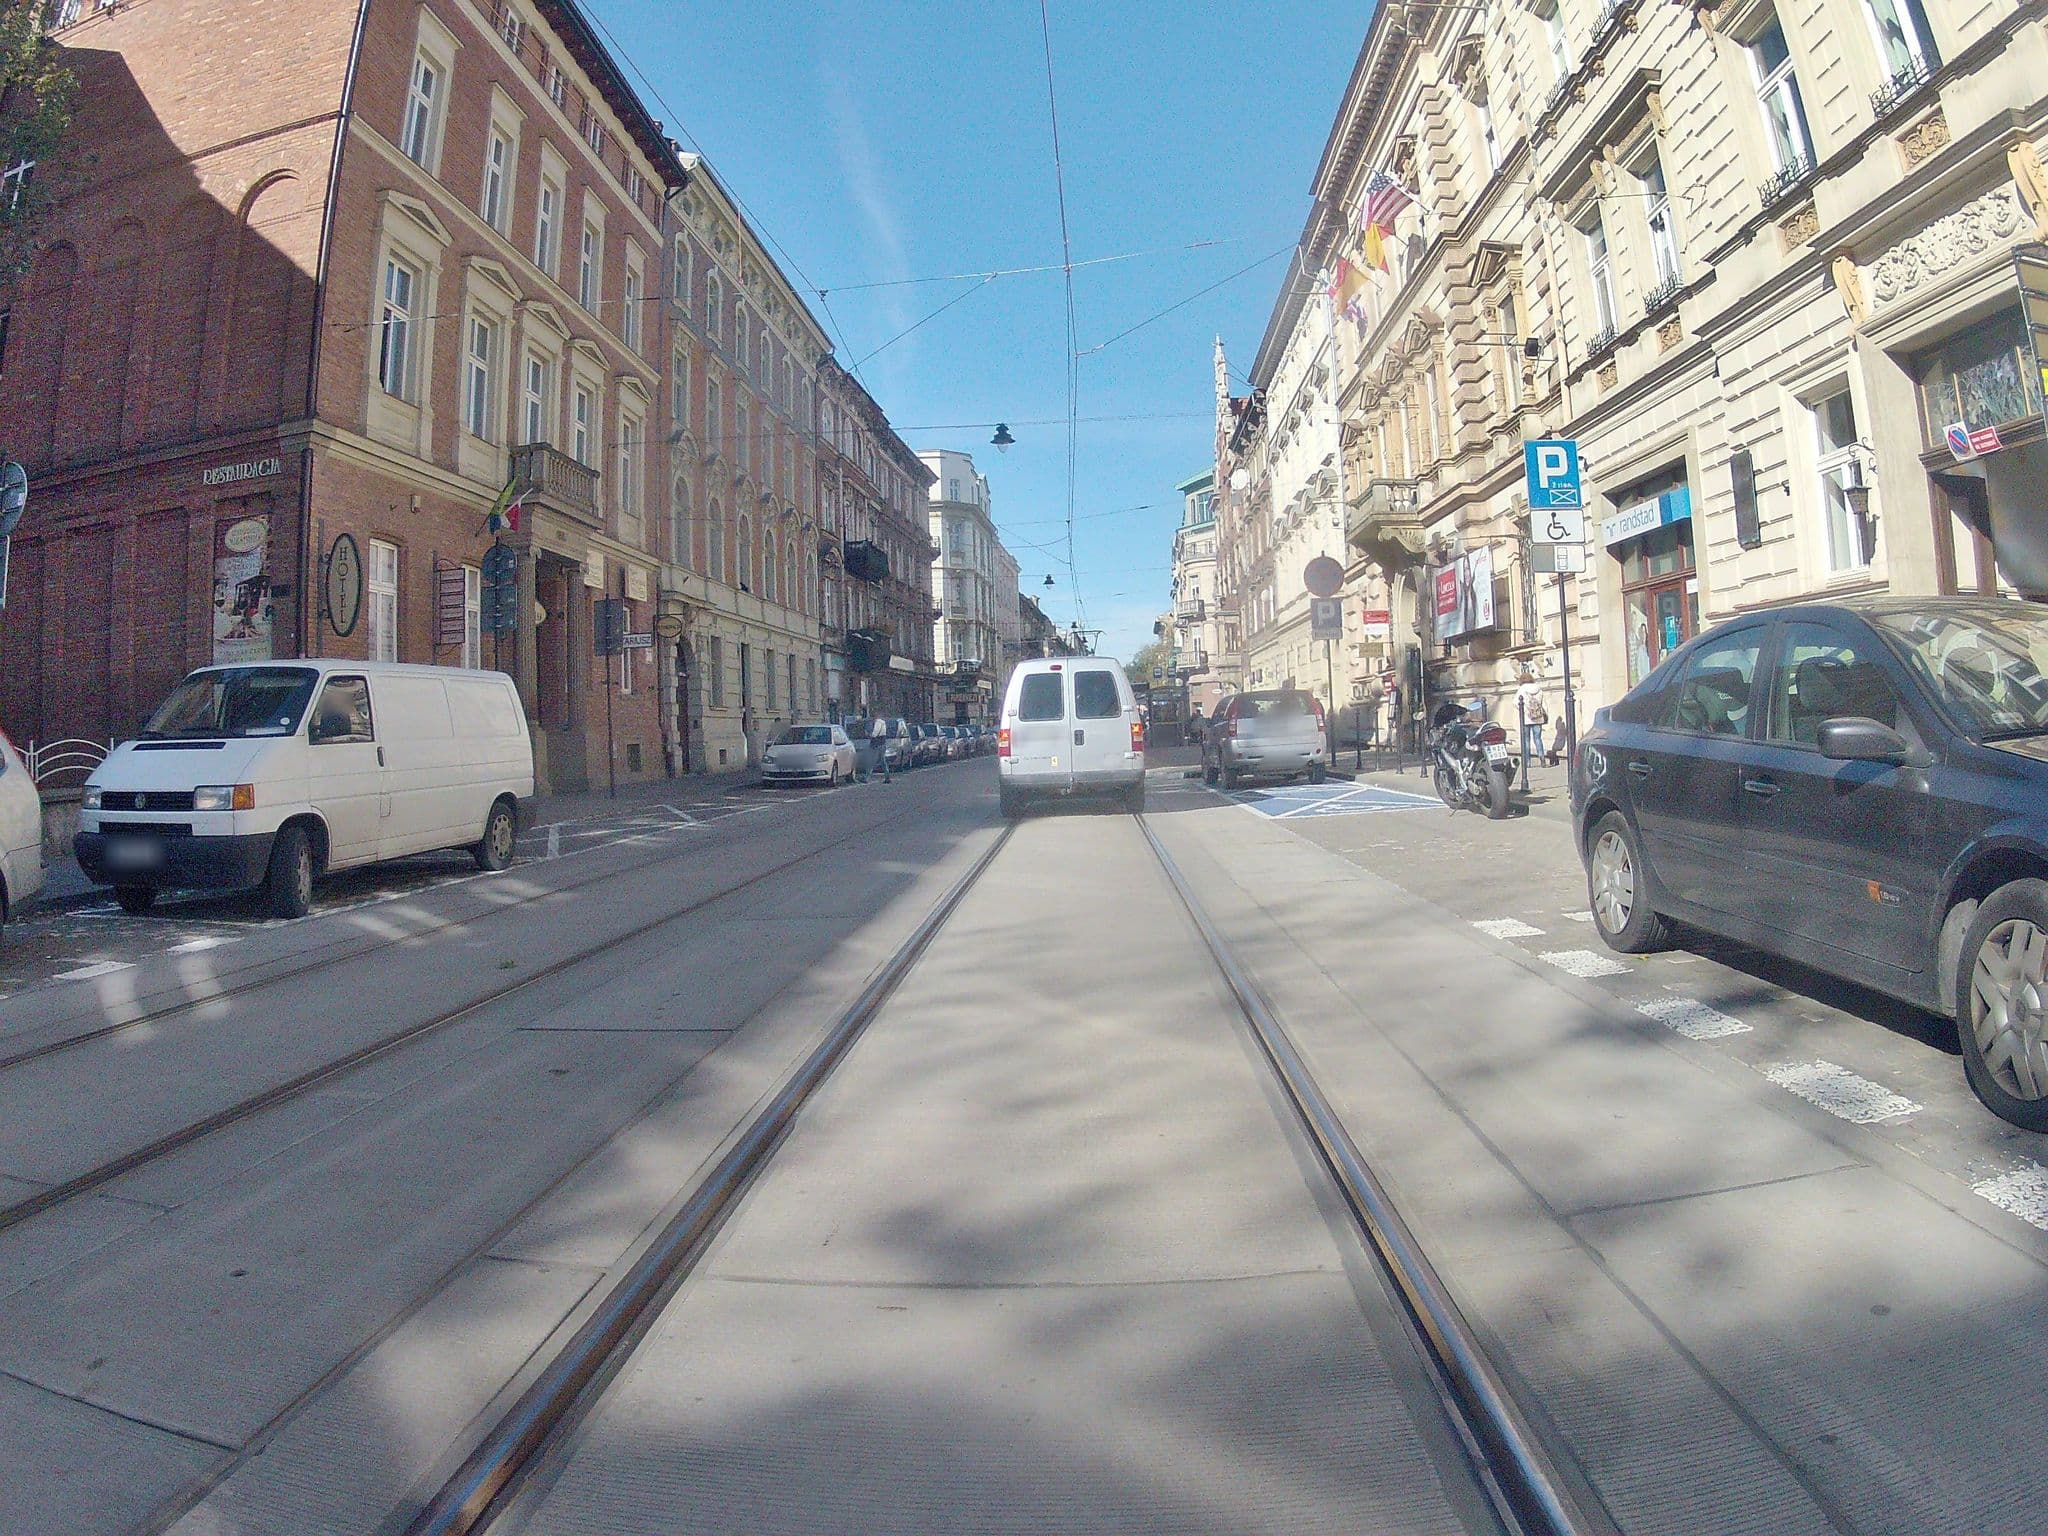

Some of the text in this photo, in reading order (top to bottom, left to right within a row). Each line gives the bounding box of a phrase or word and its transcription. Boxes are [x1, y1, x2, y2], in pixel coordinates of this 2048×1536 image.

[202, 458, 281, 485] RESTAURACJA
[1537, 446, 1568, 488] P
[1619, 501, 1655, 534] randstad
[337, 546, 349, 623] HOTEL
[1317, 601, 1335, 625] P
[622, 635, 651, 646] ARIUSZ
